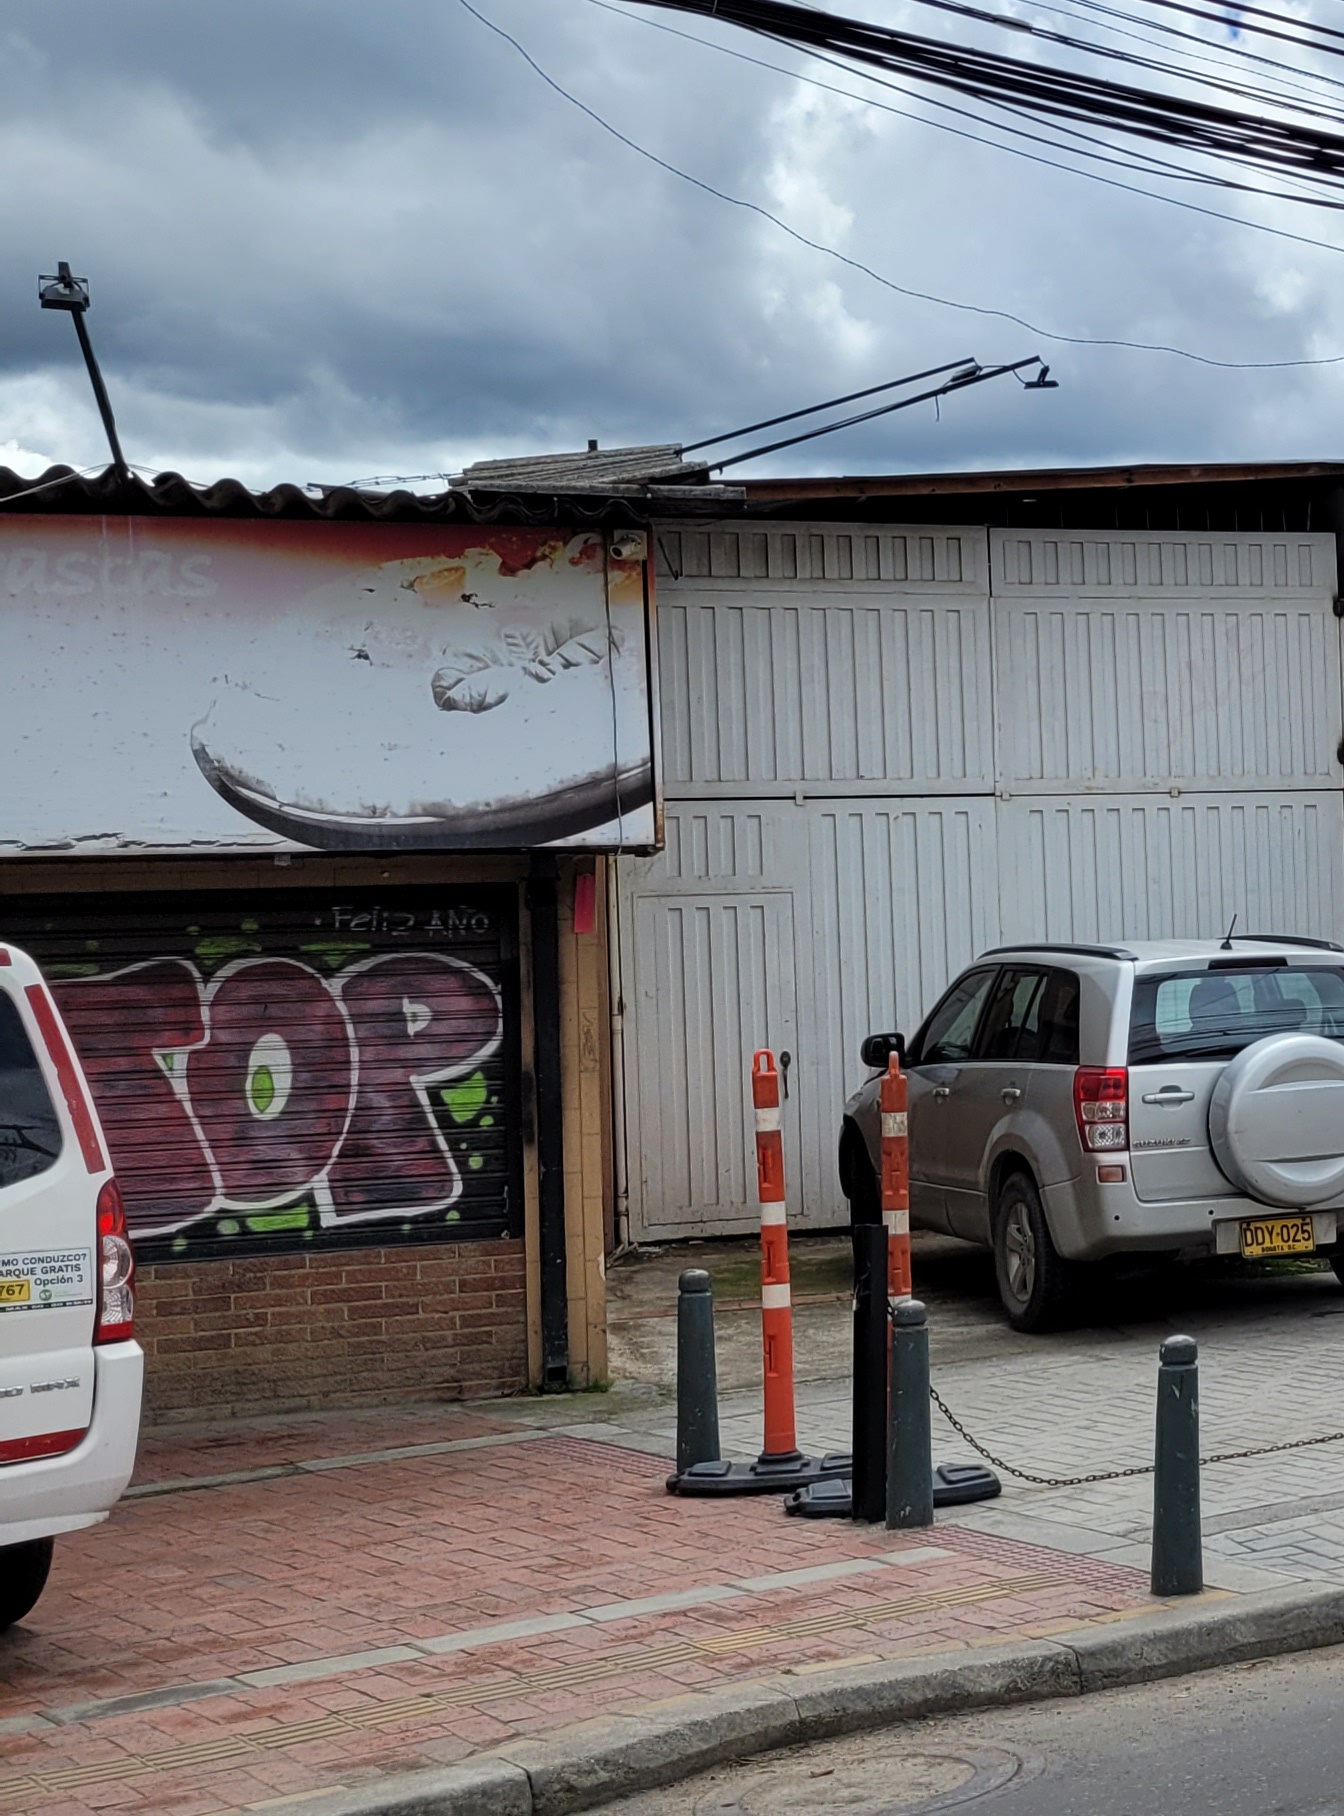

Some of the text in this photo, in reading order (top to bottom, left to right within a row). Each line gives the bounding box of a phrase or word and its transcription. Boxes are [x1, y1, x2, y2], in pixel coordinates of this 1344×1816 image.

[22, 1253, 87, 1266] CONDUZCO?
[41, 1263, 81, 1275] GRATIS
[34, 1274, 83, 1288] Opción 3
[0, 1283, 25, 1297] 767
